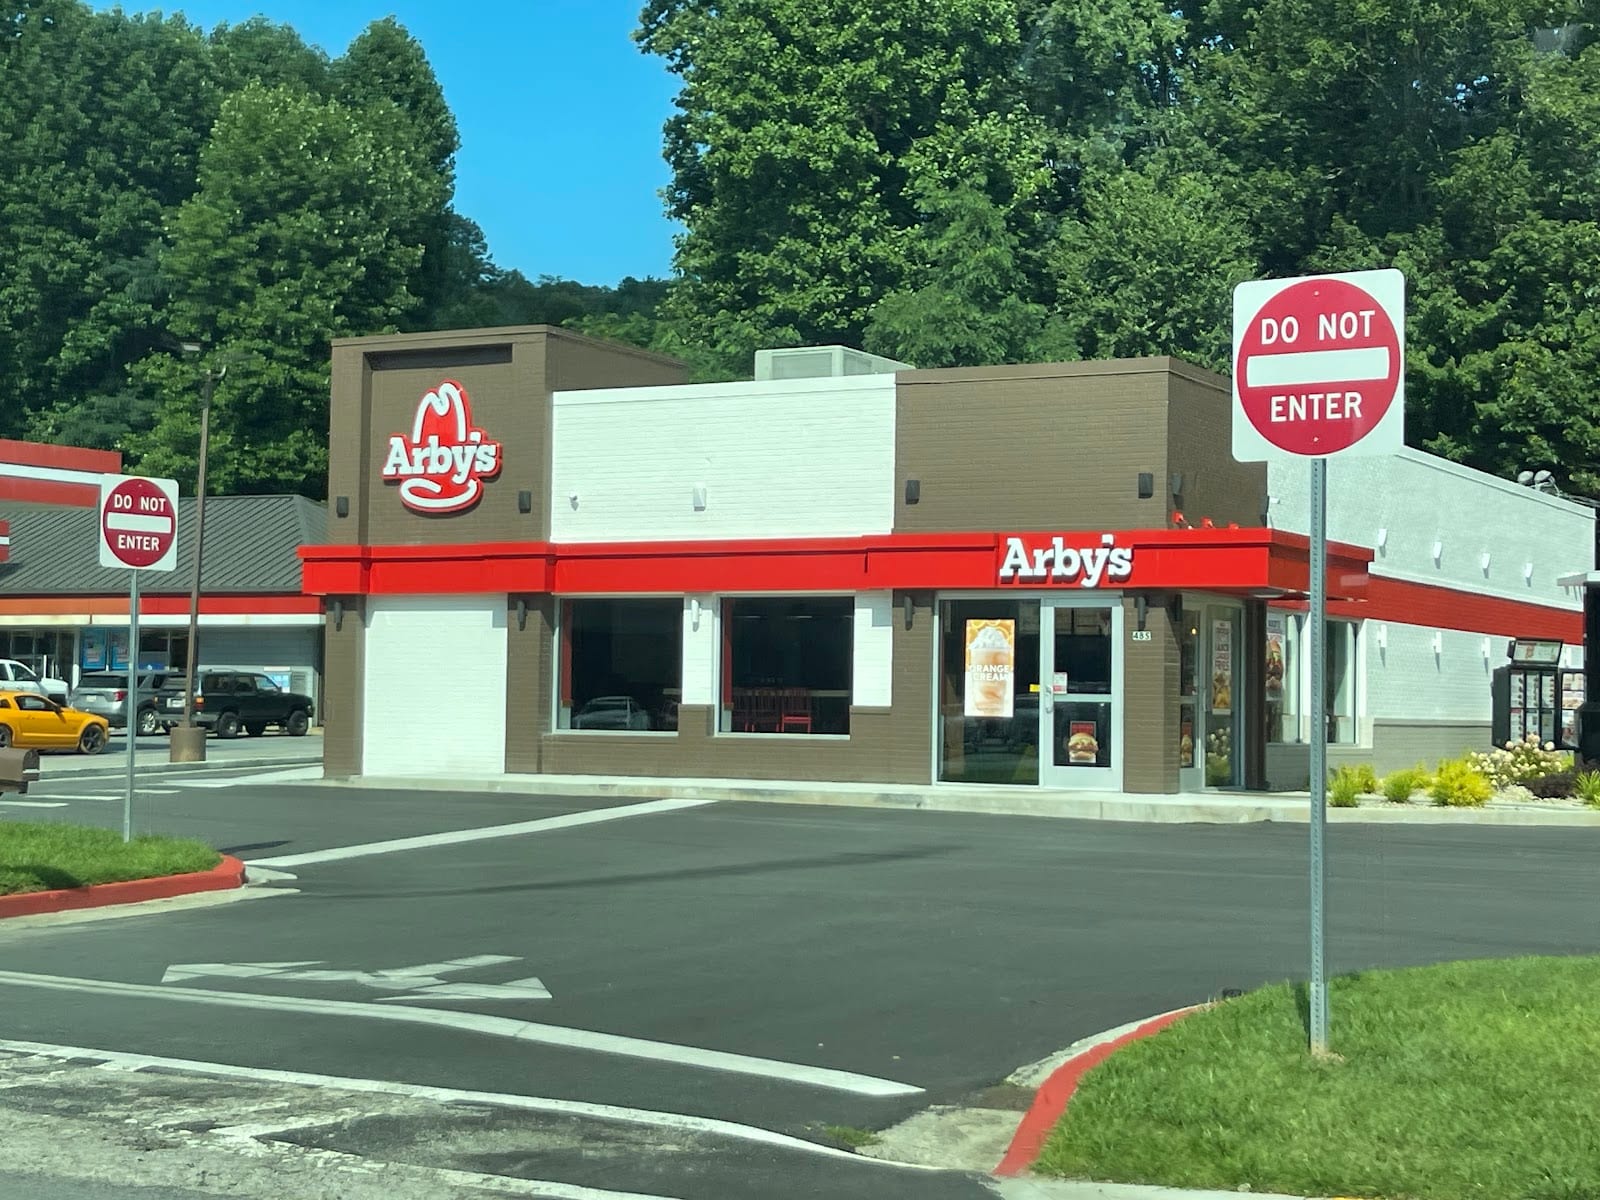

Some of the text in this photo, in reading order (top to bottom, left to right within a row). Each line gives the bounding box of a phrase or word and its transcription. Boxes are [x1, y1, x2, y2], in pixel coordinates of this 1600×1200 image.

[1260, 310, 1376, 345] DO NOT
[1270, 391, 1362, 423] ENTER
[382, 431, 497, 485] Arby's
[114, 494, 166, 512] DO NOT
[118, 534, 160, 551] ENTER
[999, 533, 1133, 588] Arby's
[1132, 631, 1151, 640] 485
[969, 664, 1009, 673] ORANGE
[972, 672, 1010, 681] CREAM
